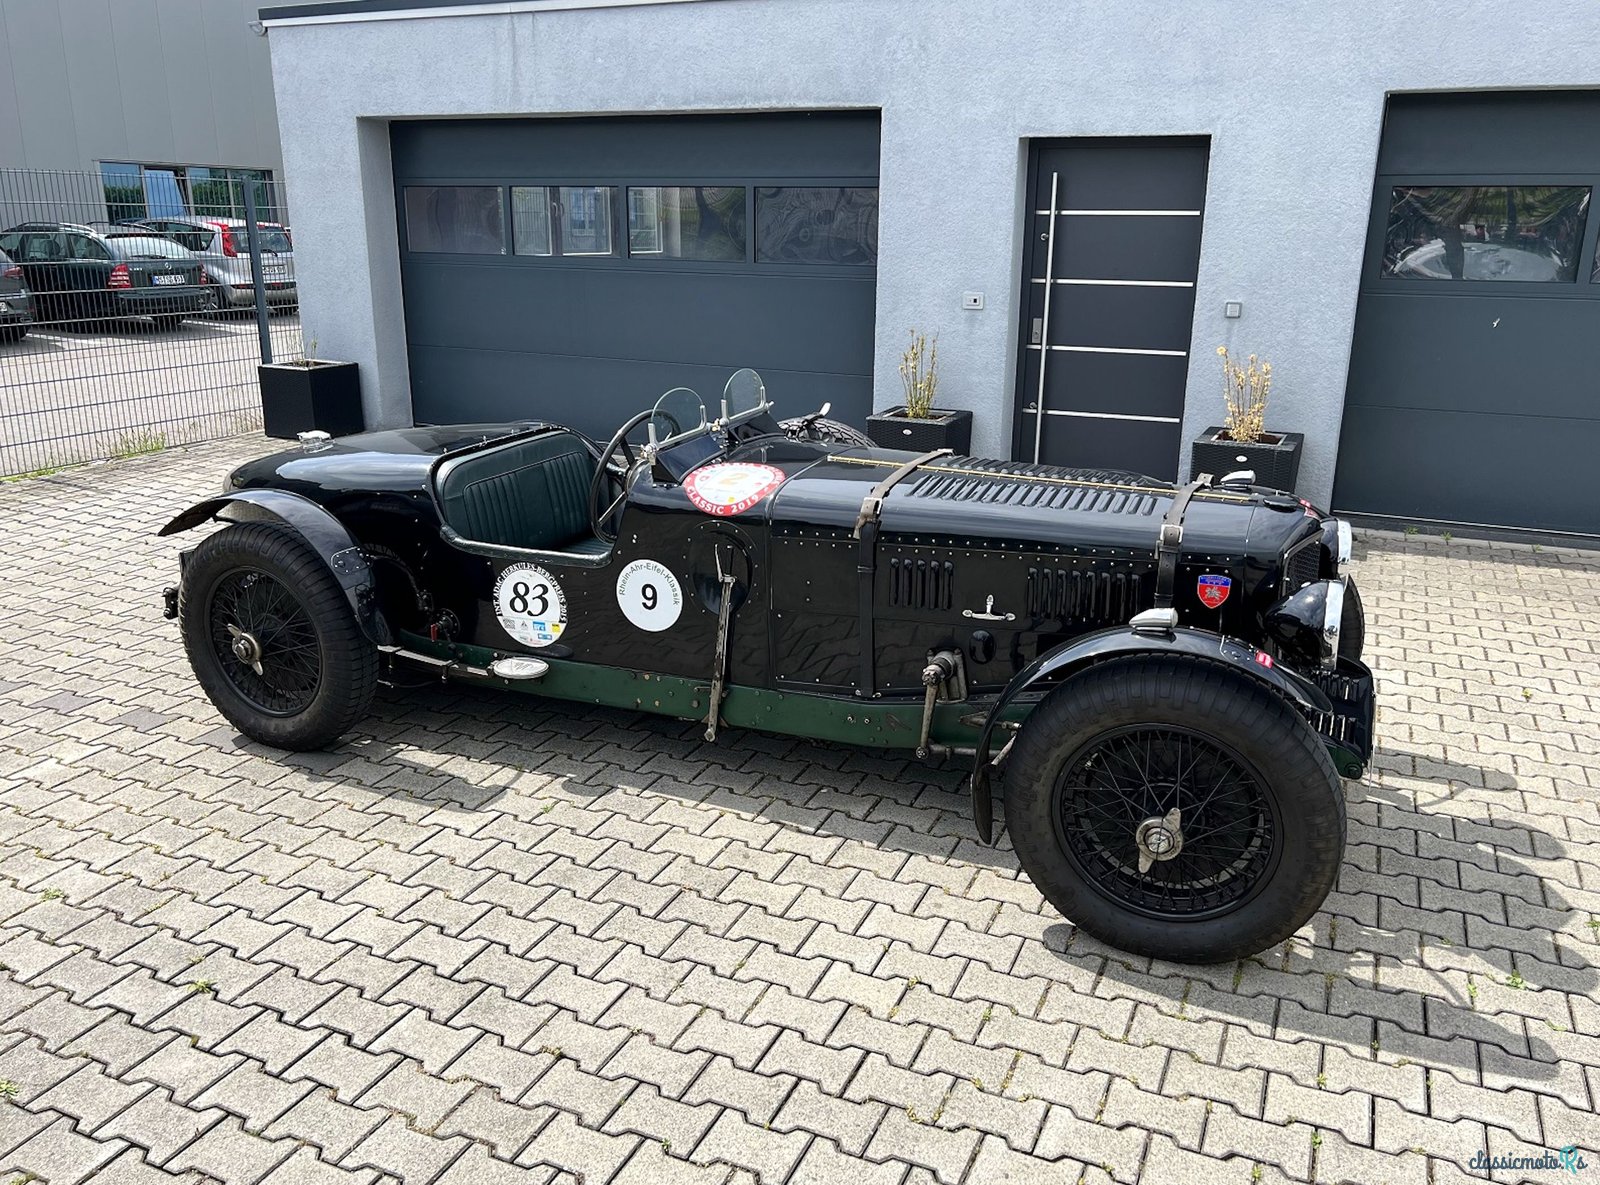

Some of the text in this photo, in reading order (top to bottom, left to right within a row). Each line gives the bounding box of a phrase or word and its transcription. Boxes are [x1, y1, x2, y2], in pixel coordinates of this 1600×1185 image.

[687, 486, 759, 514] CLASSIC 2019
[493, 576, 503, 598] ADAC
[619, 562, 680, 606] Rhein-Ahr-Eifel-Klassik
[641, 583, 658, 611] 9
[509, 581, 549, 617] 83
